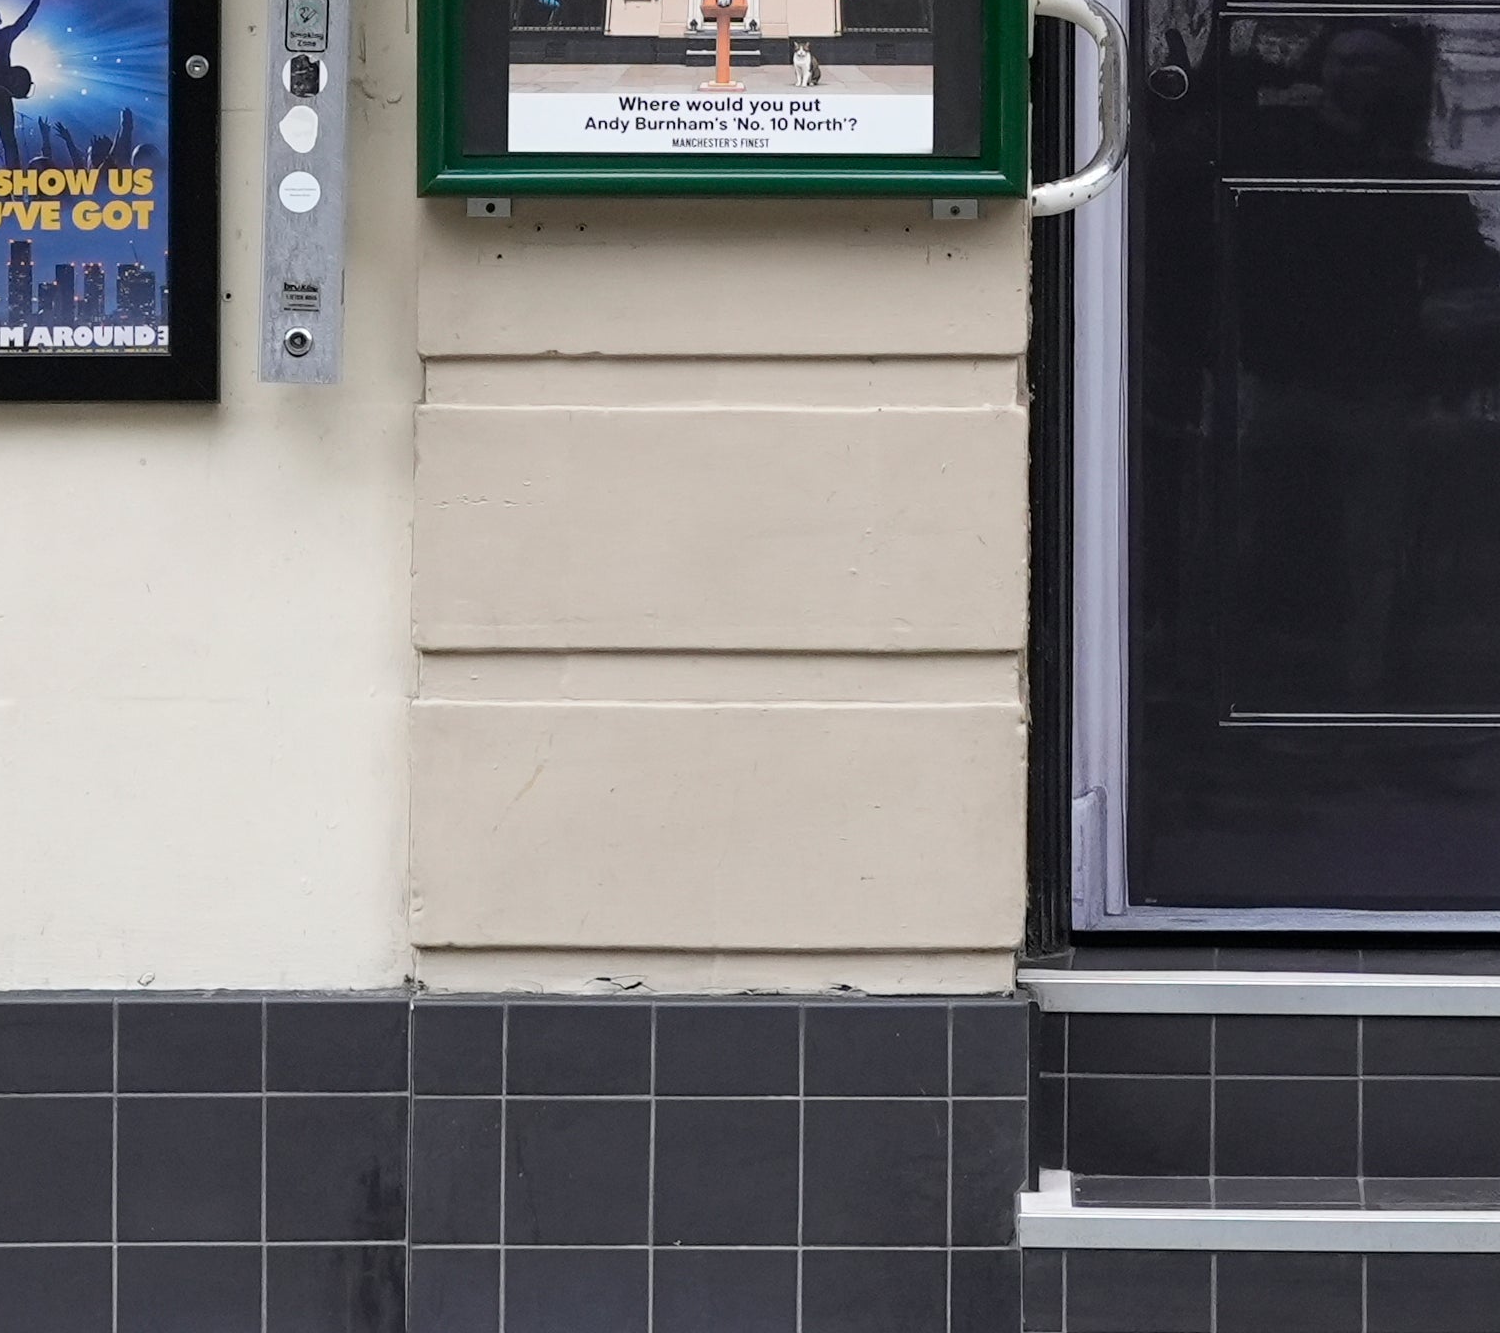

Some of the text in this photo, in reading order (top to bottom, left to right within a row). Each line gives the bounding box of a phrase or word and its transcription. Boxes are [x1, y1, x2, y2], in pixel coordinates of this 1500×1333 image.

[618, 97, 821, 116] Where would you put
[585, 117, 630, 134] Andy
[635, 117, 727, 131] Burnham's
[771, 118, 788, 131] 10
[672, 138, 770, 149] MANCHESTER'S FINEST
[108, 168, 153, 196] US
[71, 200, 154, 231] GOT
[27, 325, 156, 347] AROUND
